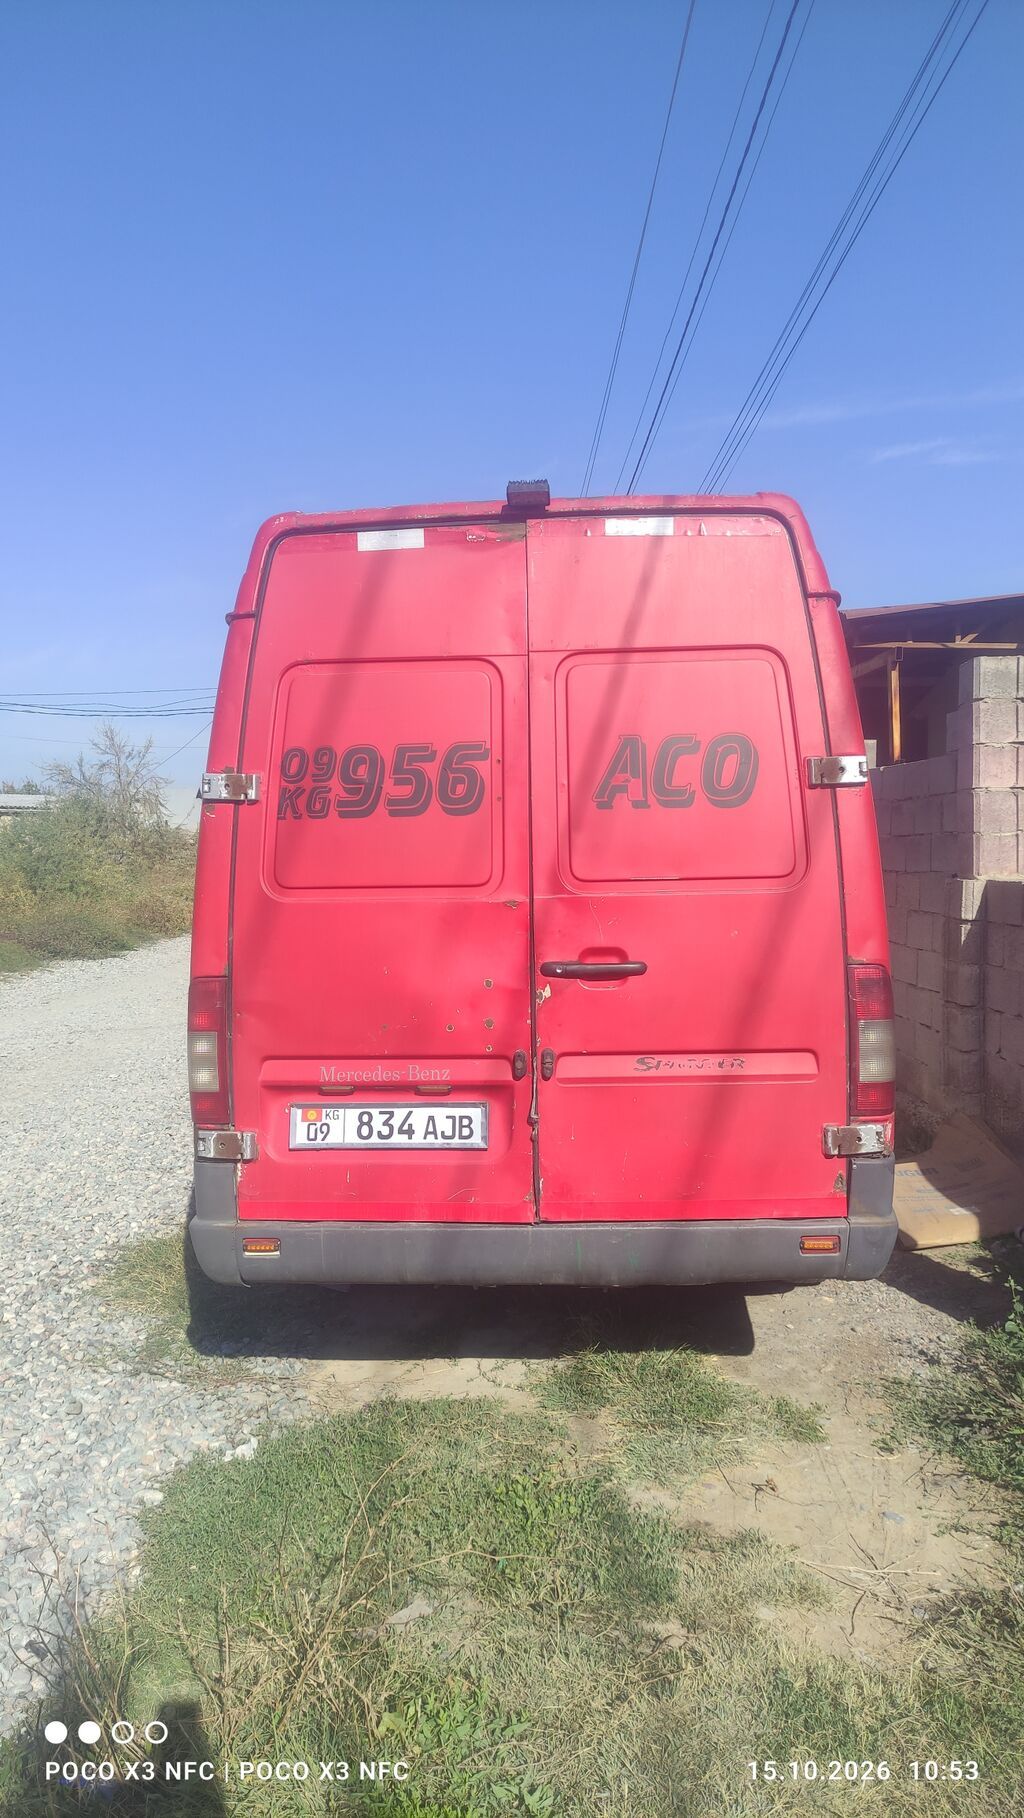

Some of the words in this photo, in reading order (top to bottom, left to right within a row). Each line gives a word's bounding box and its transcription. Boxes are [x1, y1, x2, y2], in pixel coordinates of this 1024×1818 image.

[280, 745, 337, 784] 09
[335, 741, 490, 819] 956
[592, 732, 760, 809] ACO
[277, 784, 332, 820] KG
[319, 1064, 451, 1082] Mercedes-Benz
[325, 1109, 340, 1121] KG
[356, 1110, 415, 1140] 834
[423, 1115, 474, 1140] AJB
[306, 1122, 331, 1142] 09
